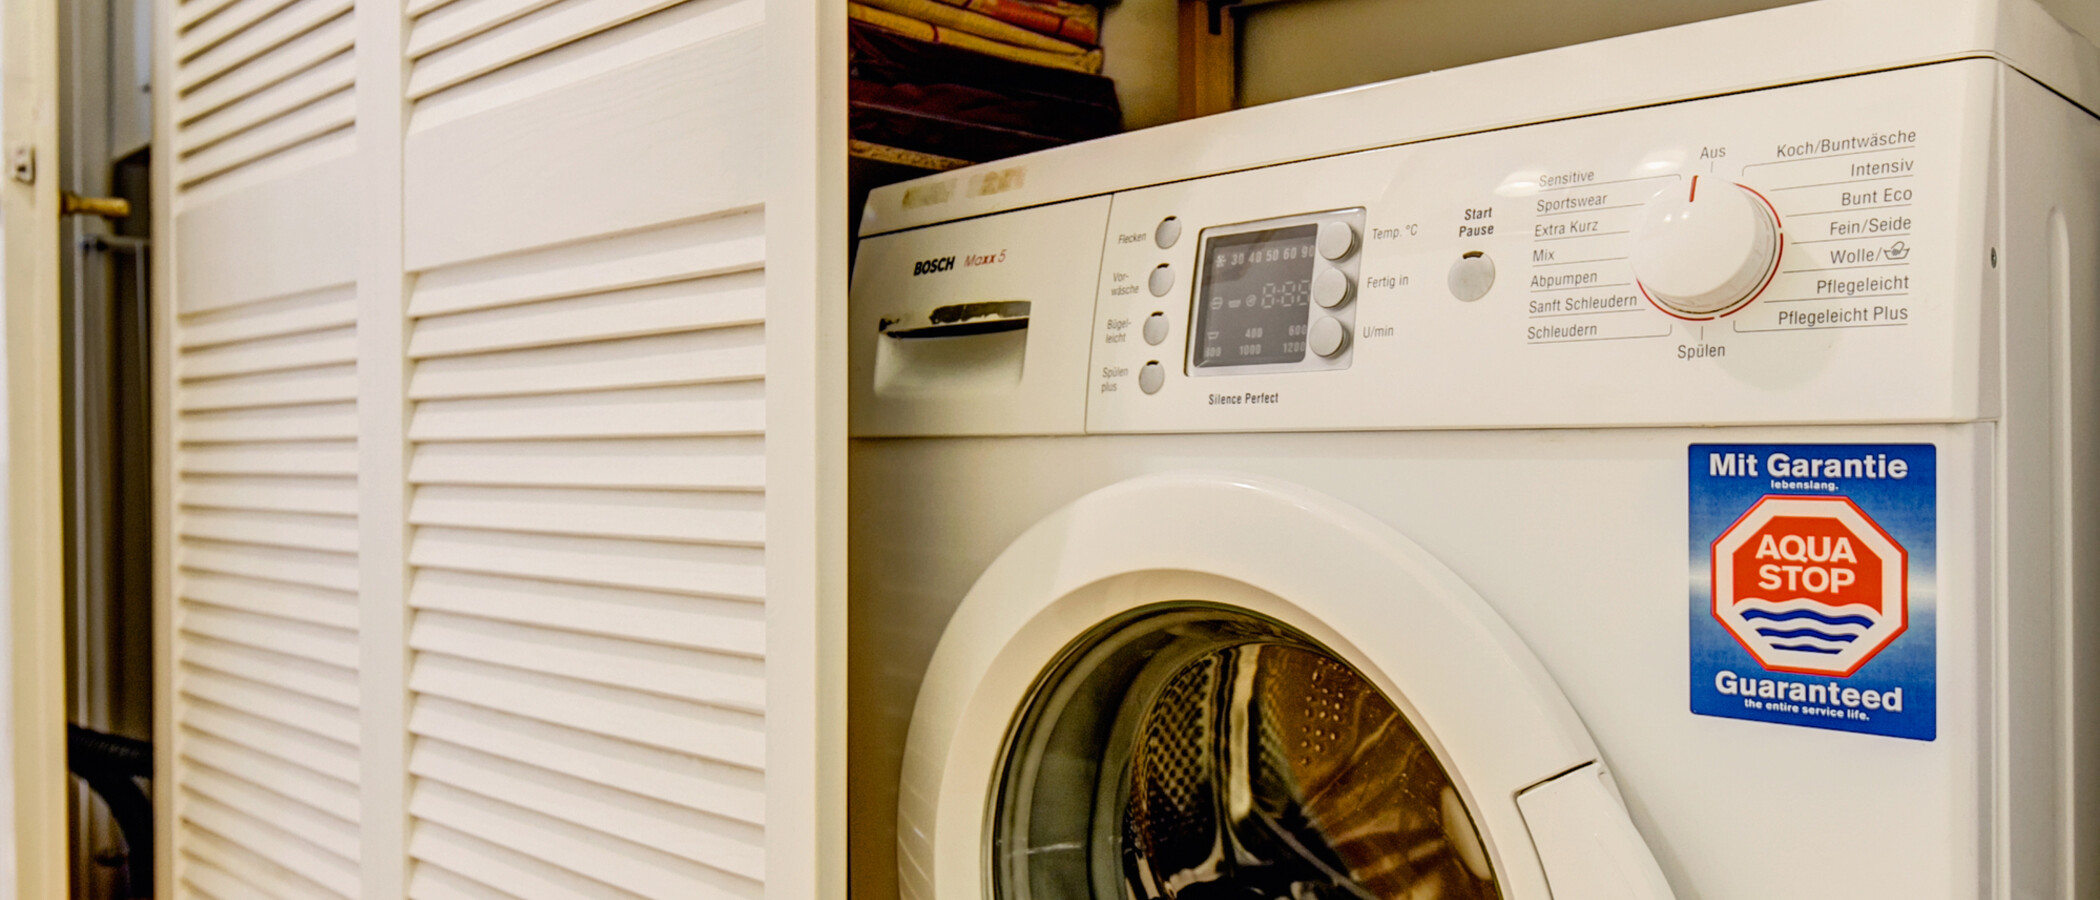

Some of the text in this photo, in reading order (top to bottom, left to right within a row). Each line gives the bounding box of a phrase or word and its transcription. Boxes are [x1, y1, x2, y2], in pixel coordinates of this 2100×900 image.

[1776, 130, 1916, 158] Koch/Buntwäsche
[1700, 147, 1726, 159] Aus
[1851, 158, 1914, 177] Intensiv
[1539, 171, 1594, 187] Sensitive
[1536, 194, 1608, 212] Sportswear
[1841, 187, 1913, 206] Bunt Eco
[1464, 207, 1492, 221] Start
[1372, 227, 1402, 241] Temp.
[1459, 224, 1494, 238] Pause
[1534, 220, 1598, 237] Extra Kurz
[1830, 216, 1912, 236] Fein/Seide
[1118, 233, 1147, 244] Flecken
[913, 248, 1007, 276] BOSCH Maxx 5
[1231, 245, 1315, 266] 30 40 50 60 90
[1532, 249, 1555, 262] Mix
[1113, 272, 1129, 282] Vor-
[1367, 274, 1409, 289] Fertig in
[1530, 272, 1598, 288] Abpumpen
[1817, 275, 1909, 295] Pflegeleicht
[1529, 295, 1637, 314] Sanft Schleudern
[1778, 305, 1908, 327] Pflegeleicht Plus
[1107, 319, 1131, 331] Bügel-
[1245, 325, 1307, 338] 400 600
[1363, 325, 1394, 339] U/min
[1527, 324, 1597, 340] Schleudern
[1105, 333, 1126, 343] leicht
[1240, 344, 1262, 355] 1000
[1677, 344, 1726, 361] Spülen
[1102, 366, 1128, 378] Spülen
[1101, 382, 1117, 394] plus
[1208, 392, 1279, 405] Silence Perfect
[1709, 453, 1908, 479] Mit Garantie
[1770, 480, 1839, 491] lebenslang.
[1755, 534, 1857, 564] AQUA
[1758, 564, 1856, 594] STOP
[1715, 670, 1903, 712] Guaranteed
[1744, 698, 1870, 721] the entire service life.
